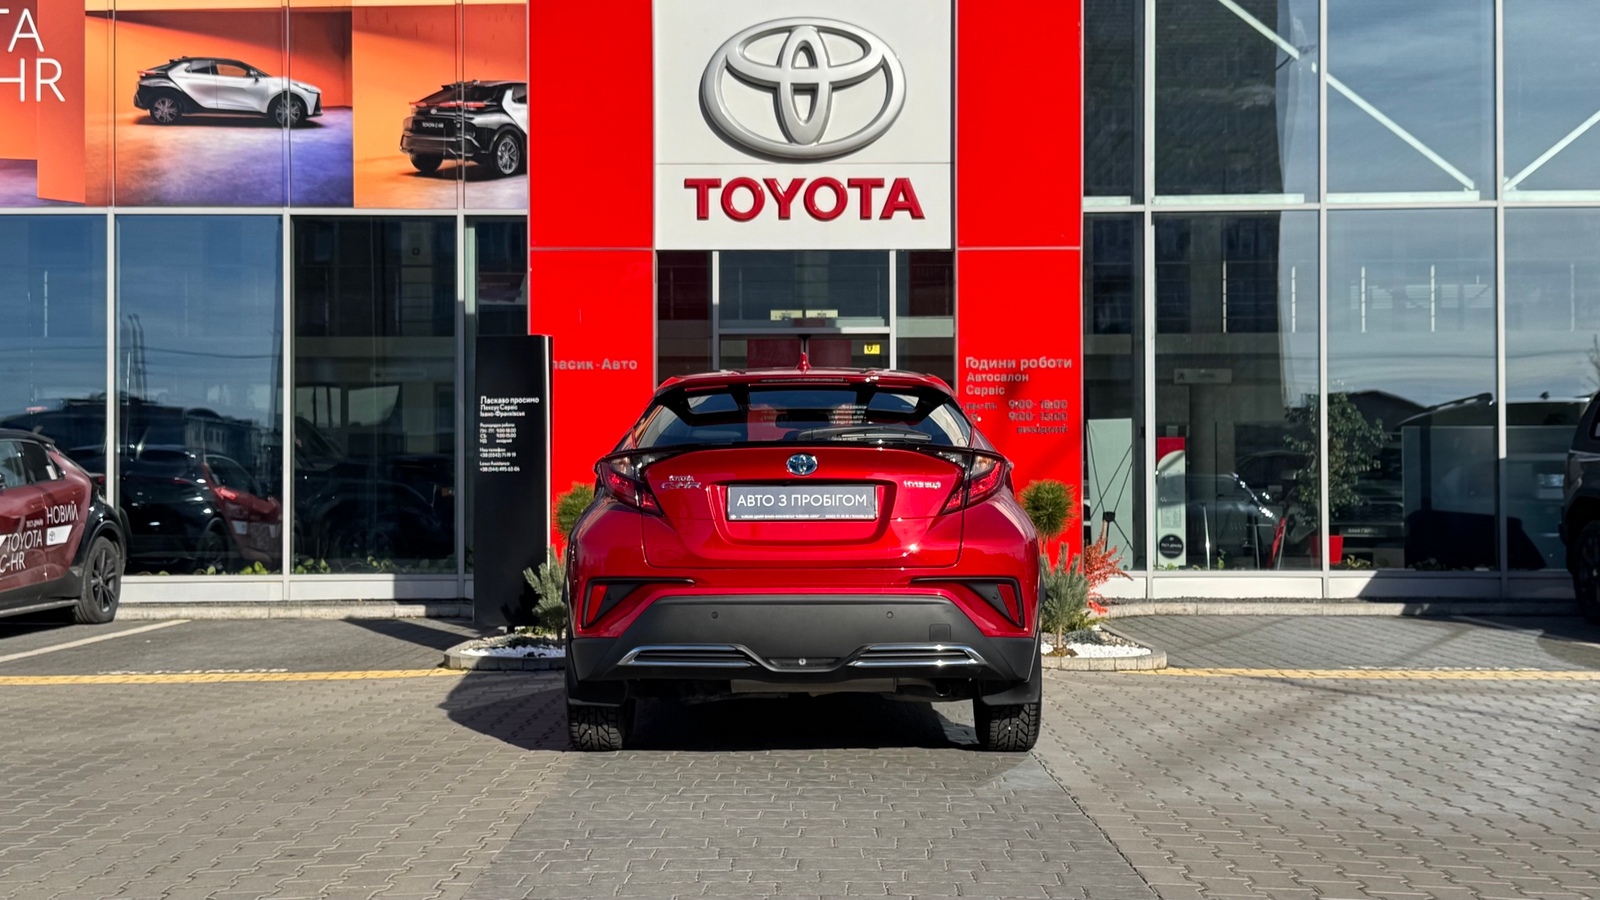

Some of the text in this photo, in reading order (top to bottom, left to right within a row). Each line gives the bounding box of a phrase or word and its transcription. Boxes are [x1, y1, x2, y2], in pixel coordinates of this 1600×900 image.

[684, 177, 925, 221] TOYOTA
[966, 356, 1072, 371] Години роботи
[967, 372, 1029, 382] Автосалон
[966, 385, 1005, 397] Сервіс
[737, 494, 774, 507] АВТО
[791, 494, 867, 506] ПРОБІГОМ
[46, 500, 78, 524] НОВИЙ
[6, 530, 42, 552] TOYOTA
[0, 552, 26, 573] C-HR
